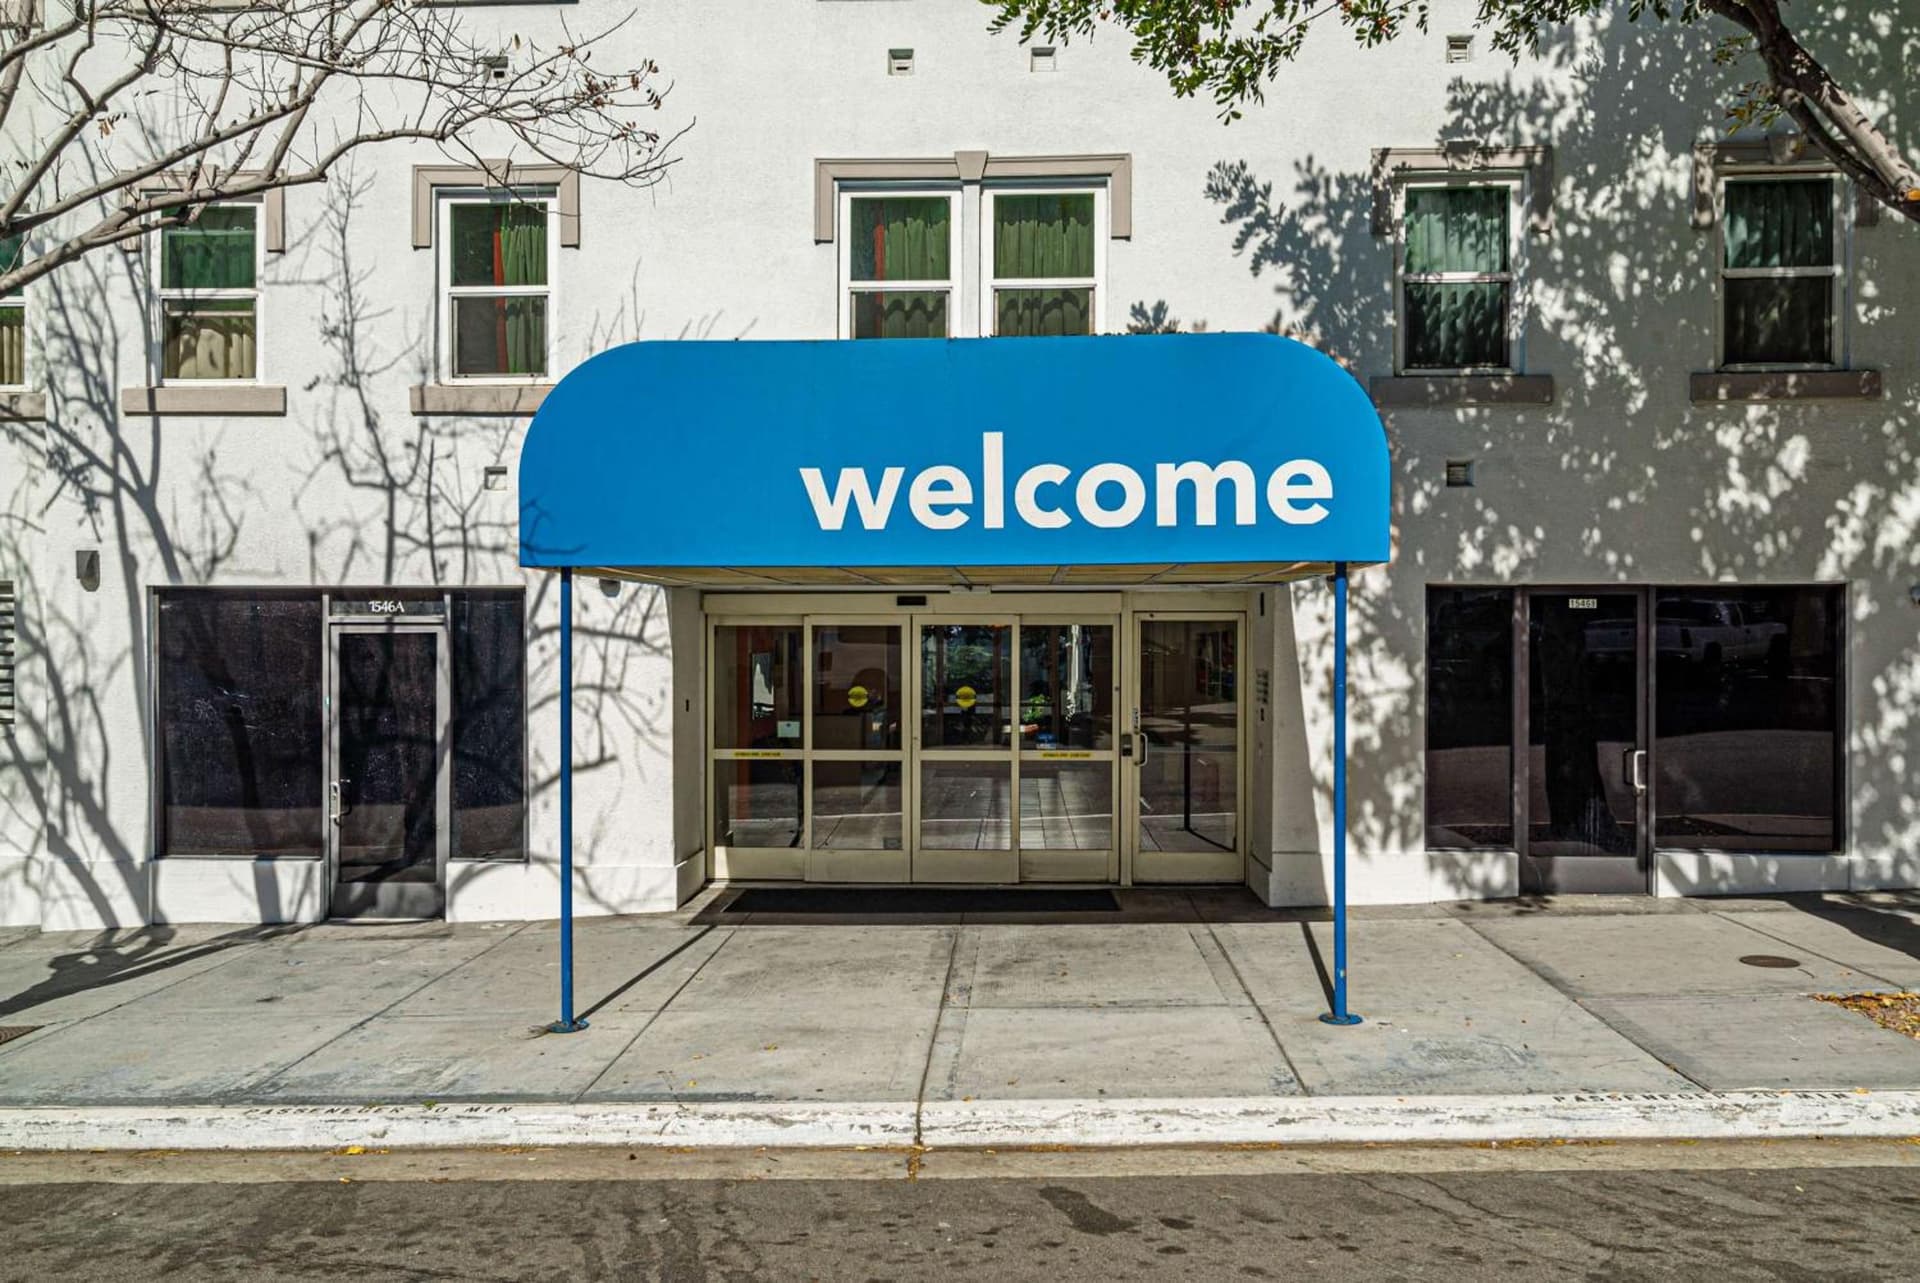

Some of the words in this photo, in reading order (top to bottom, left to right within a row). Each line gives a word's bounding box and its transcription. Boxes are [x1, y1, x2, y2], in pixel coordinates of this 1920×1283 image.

[799, 431, 1333, 530] welcome
[368, 600, 405, 613] 1546A
[463, 1106, 513, 1114] MIN
